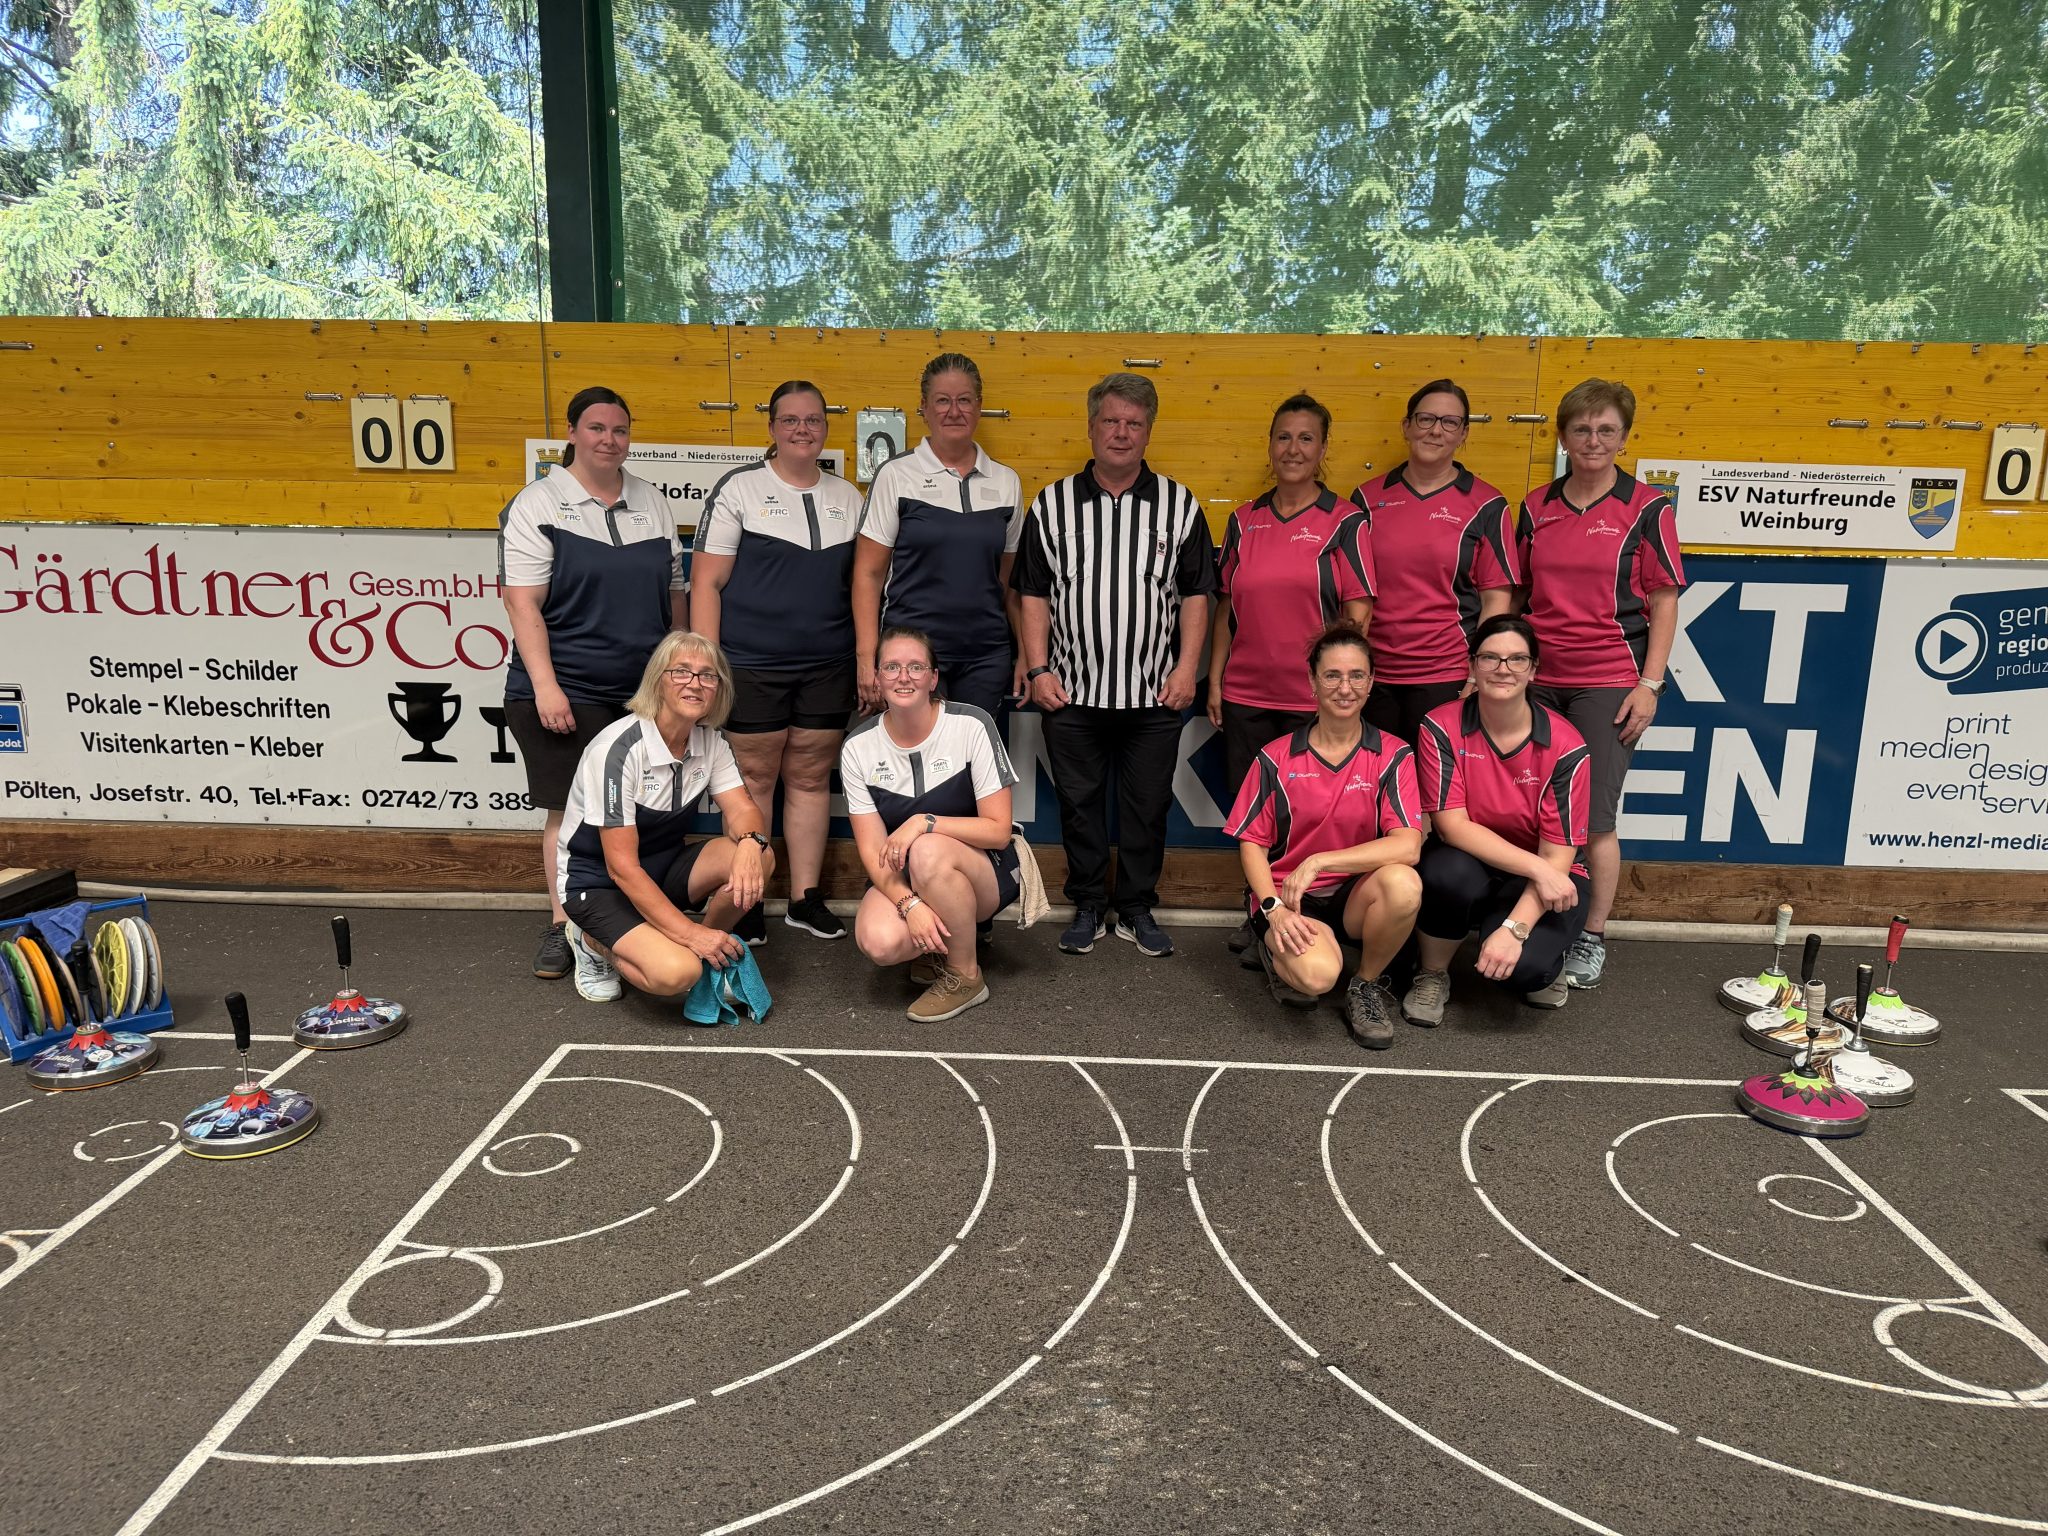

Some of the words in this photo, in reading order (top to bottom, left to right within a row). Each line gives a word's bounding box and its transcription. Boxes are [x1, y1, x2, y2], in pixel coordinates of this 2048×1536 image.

[1711, 468, 1790, 480] Landesverband
[1800, 470, 1886, 483] Niederösterreich
[1997, 447, 2032, 496] 0
[652, 482, 709, 500] Hofa
[1698, 485, 1740, 503] ESV
[1746, 486, 1896, 509] Naturfreunde
[769, 508, 789, 516] FRC
[1740, 510, 1849, 536] Weinburg
[89, 655, 184, 683] Stempel
[205, 657, 299, 682] Schilder
[66, 692, 142, 716] Pokale
[163, 695, 331, 719] Klebeschriften
[1946, 712, 2012, 743] print
[80, 731, 229, 756] Visitenkarten
[250, 735, 325, 758] Kleber
[1880, 737, 1990, 760] medien
[879, 773, 895, 782] FRC
[4, 780, 82, 804] Pölten,
[89, 783, 191, 803] Josefstr.
[199, 785, 239, 808] 40,
[249, 787, 350, 807] Tel.+Fax:
[361, 788, 479, 811] 02742/73
[1906, 780, 1989, 801] event
